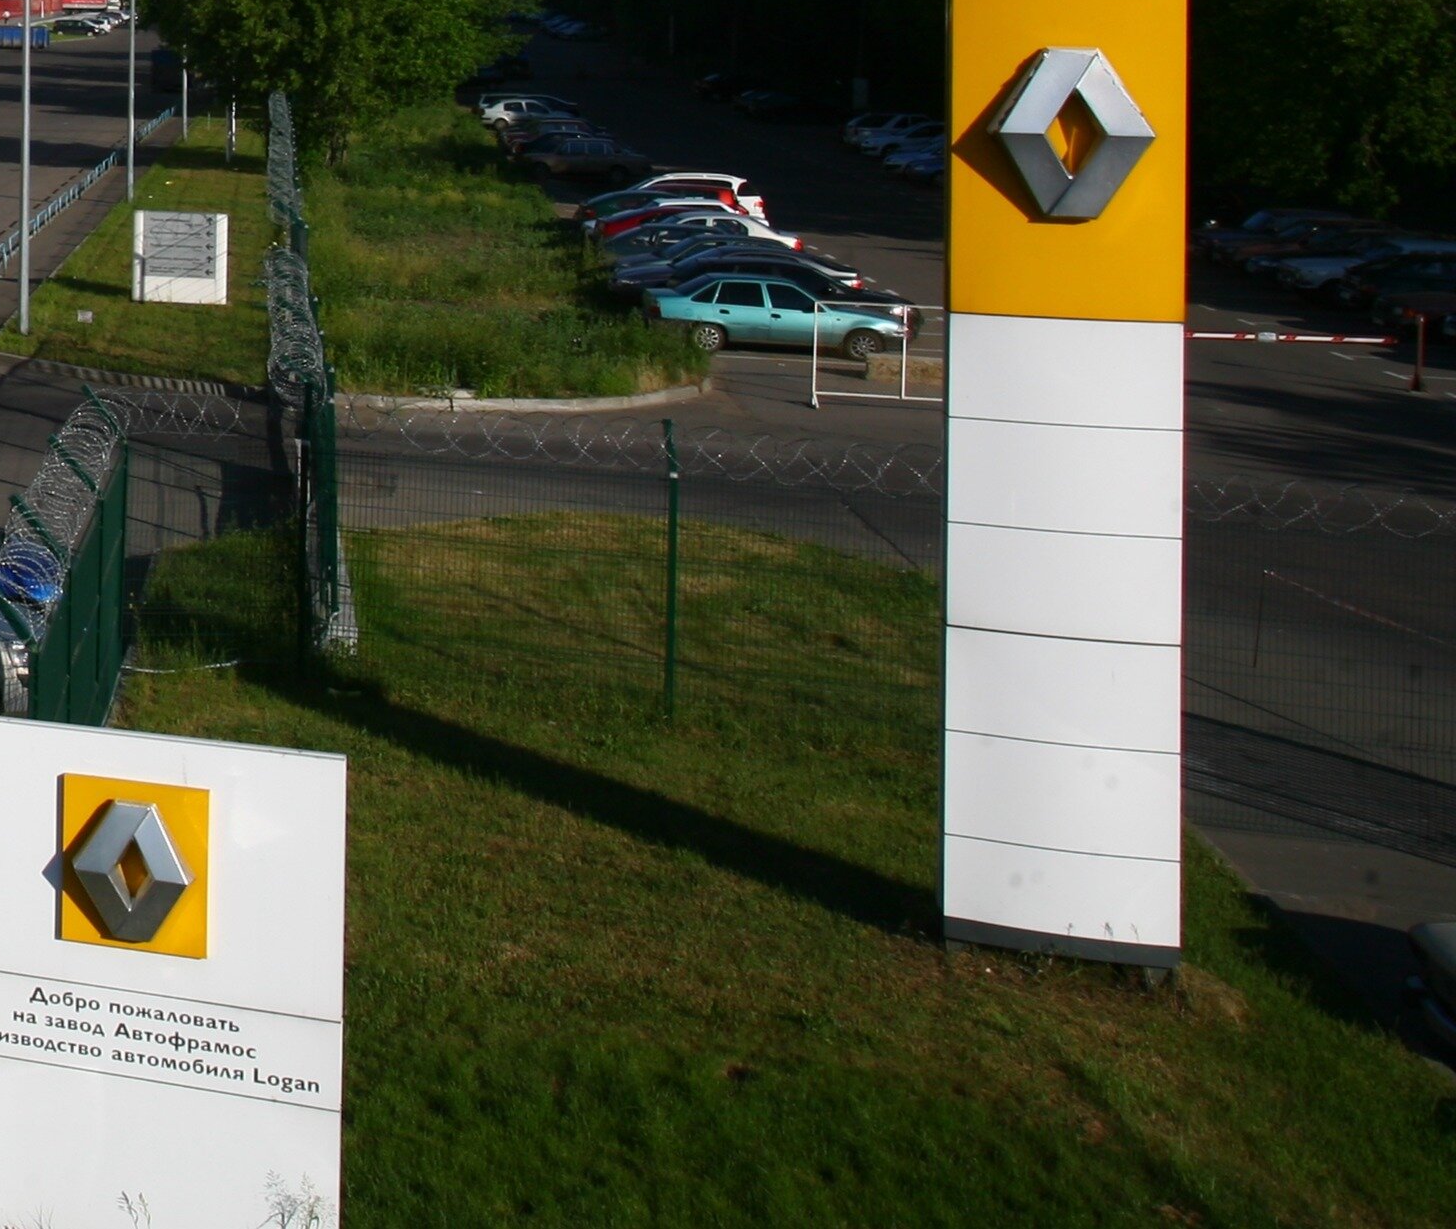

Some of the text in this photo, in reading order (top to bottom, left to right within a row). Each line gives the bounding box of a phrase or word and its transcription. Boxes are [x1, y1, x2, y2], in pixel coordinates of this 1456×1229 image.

[29, 986, 241, 1034] Добро пожаловать
[12, 1010, 258, 1060] на завод Автофрамос
[111, 1049, 245, 1082] автомобиля
[252, 1067, 321, 1093] Logan
